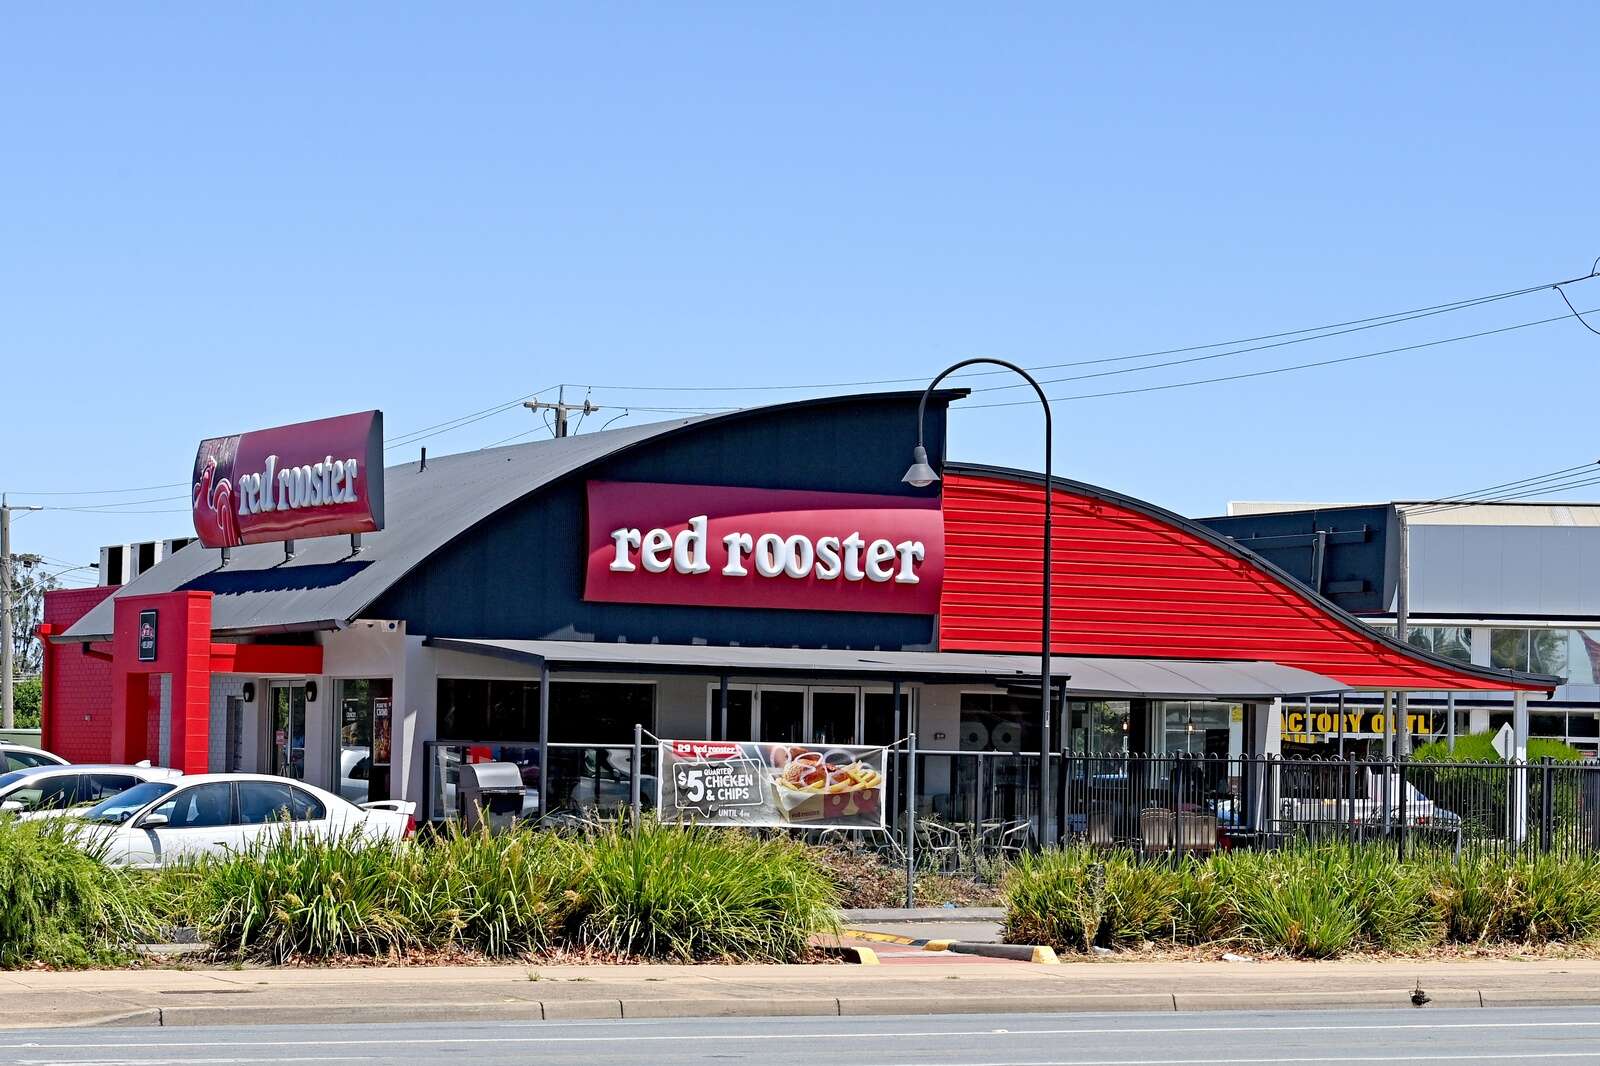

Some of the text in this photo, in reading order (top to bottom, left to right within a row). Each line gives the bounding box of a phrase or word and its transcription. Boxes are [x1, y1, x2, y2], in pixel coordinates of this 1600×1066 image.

[239, 454, 358, 515] red rooster
[609, 514, 925, 584] red rooster
[1371, 714, 1431, 734] OTL
[678, 770, 705, 802] $5
[705, 774, 754, 788] CHICKEN
[706, 787, 750, 801] & CHIPS
[718, 809, 738, 817] UNTIL
